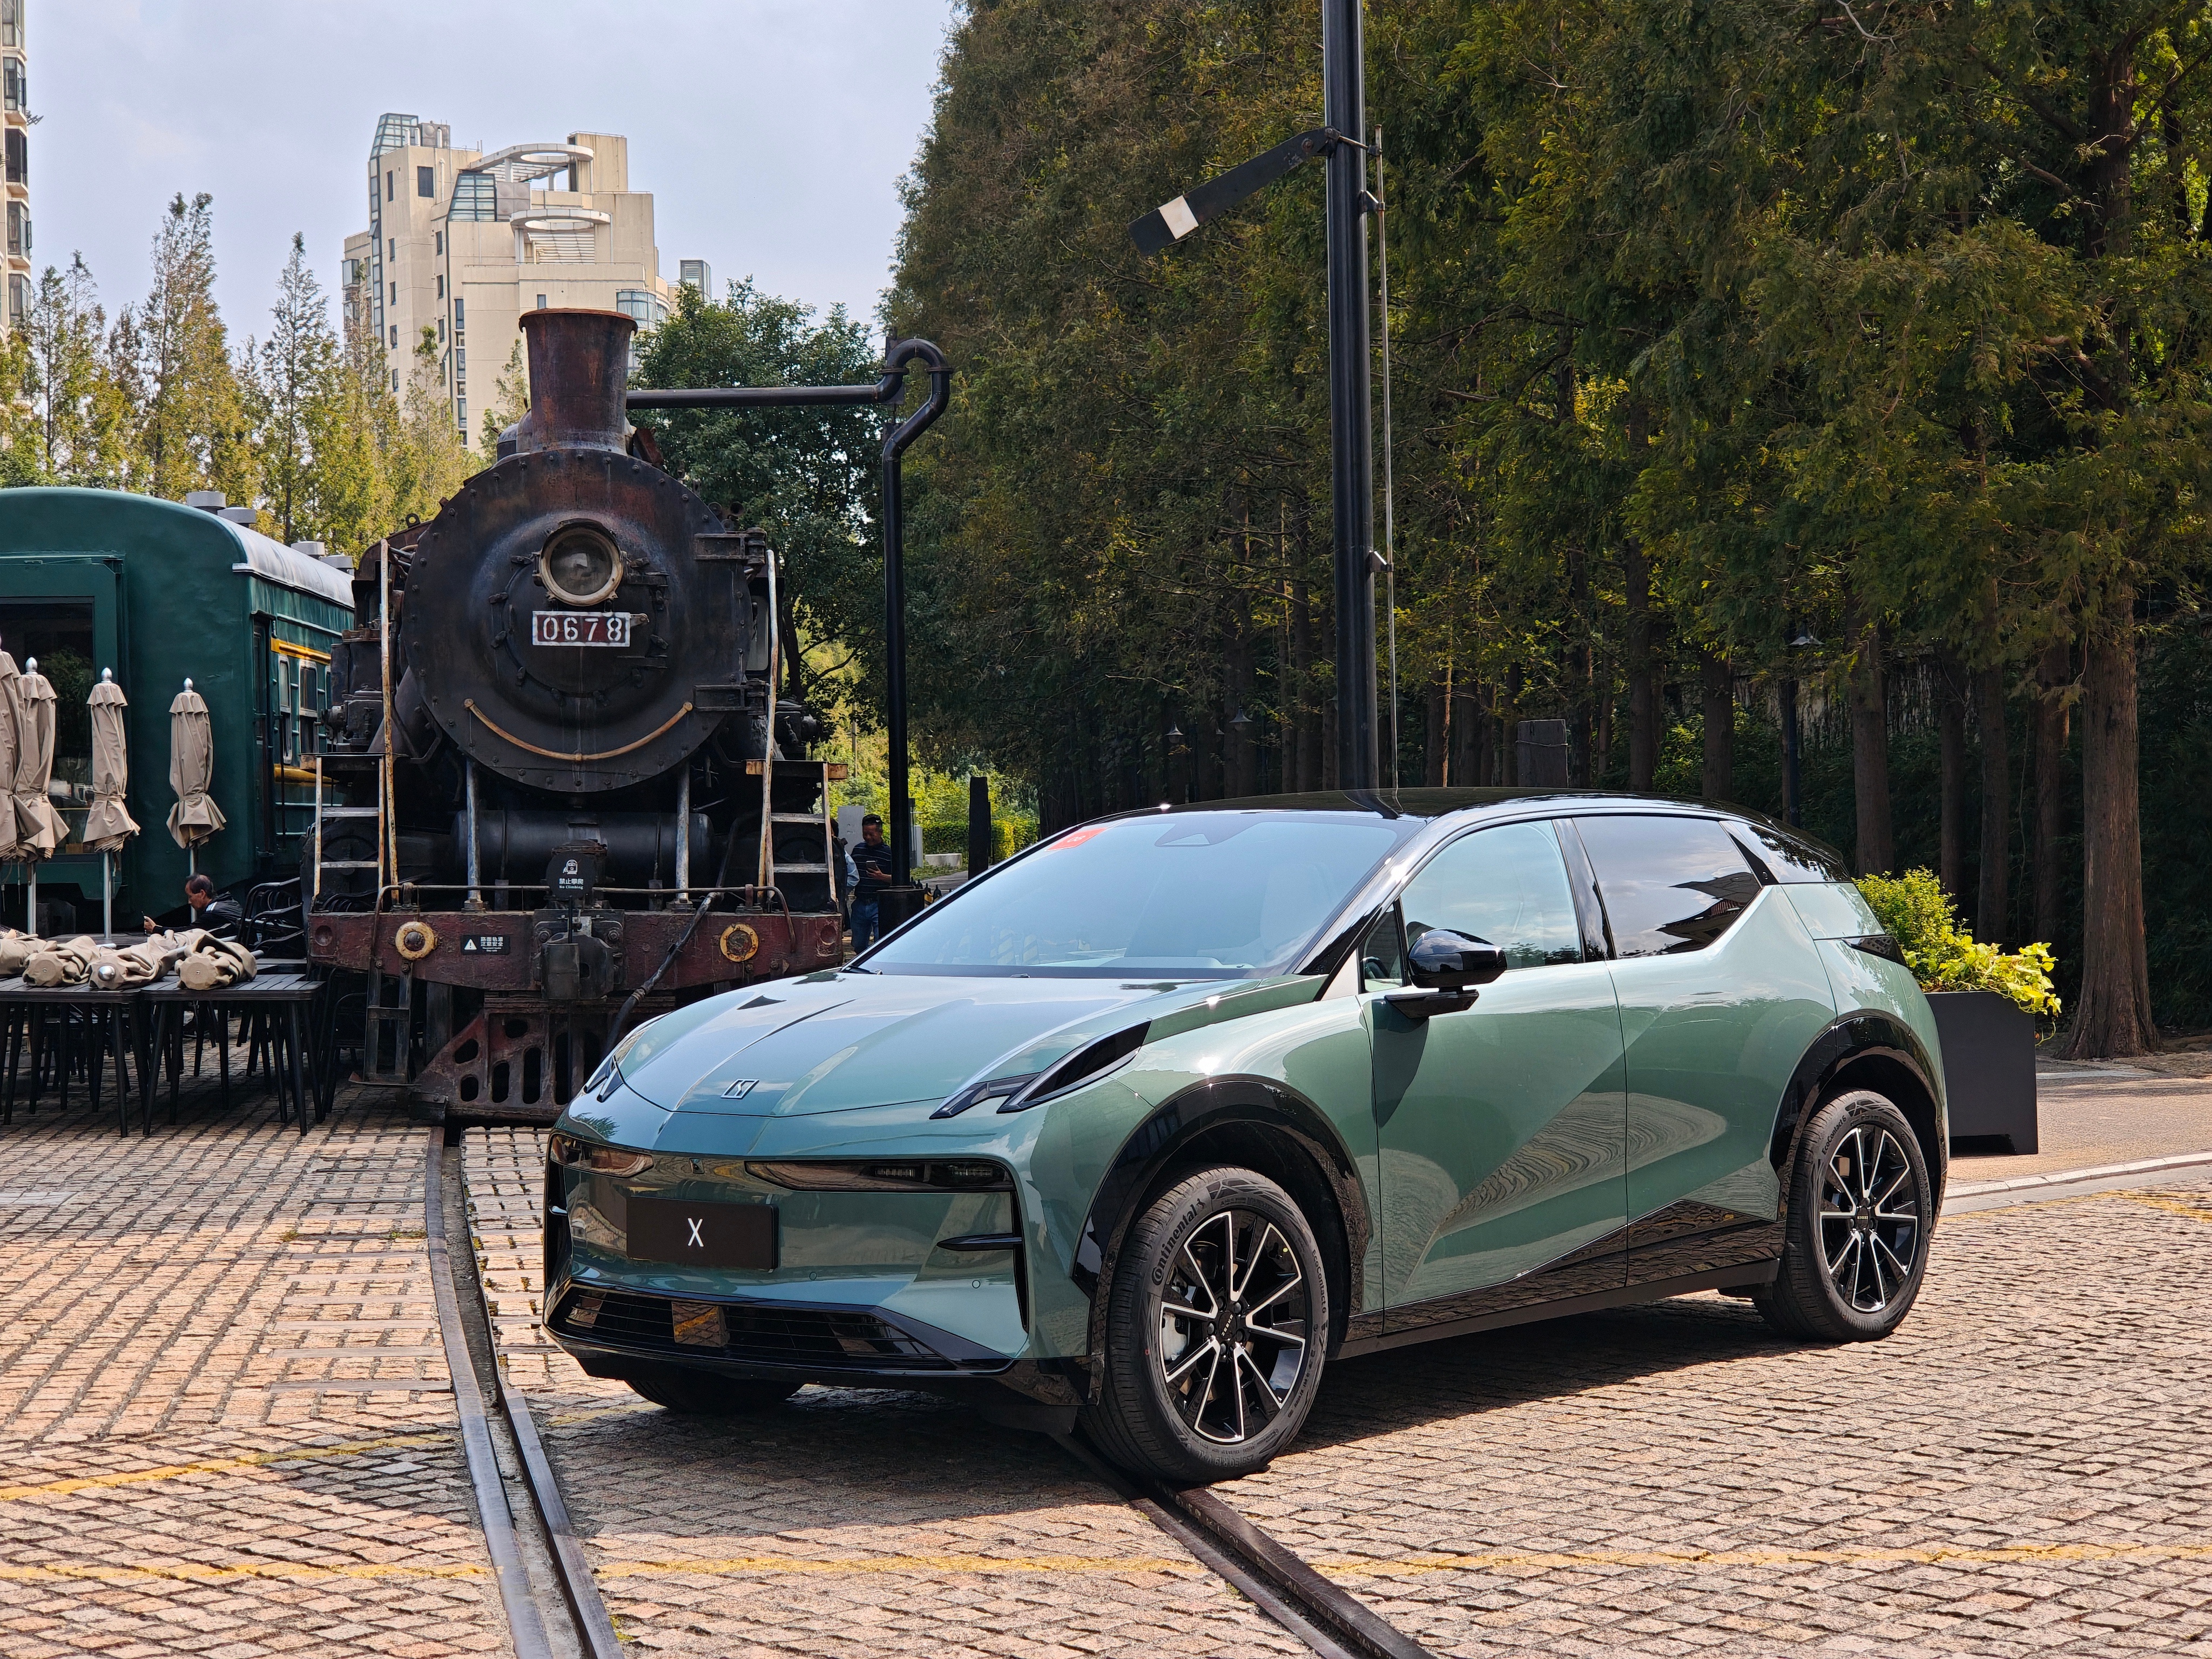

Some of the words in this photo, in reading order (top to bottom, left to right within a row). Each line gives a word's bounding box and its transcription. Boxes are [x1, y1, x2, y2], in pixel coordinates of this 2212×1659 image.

[543, 617, 622, 642] 0678
[687, 1218, 704, 1247] X
[1151, 1204, 1197, 1285] Continental
[1221, 1314, 1233, 1337] ZEEKR
